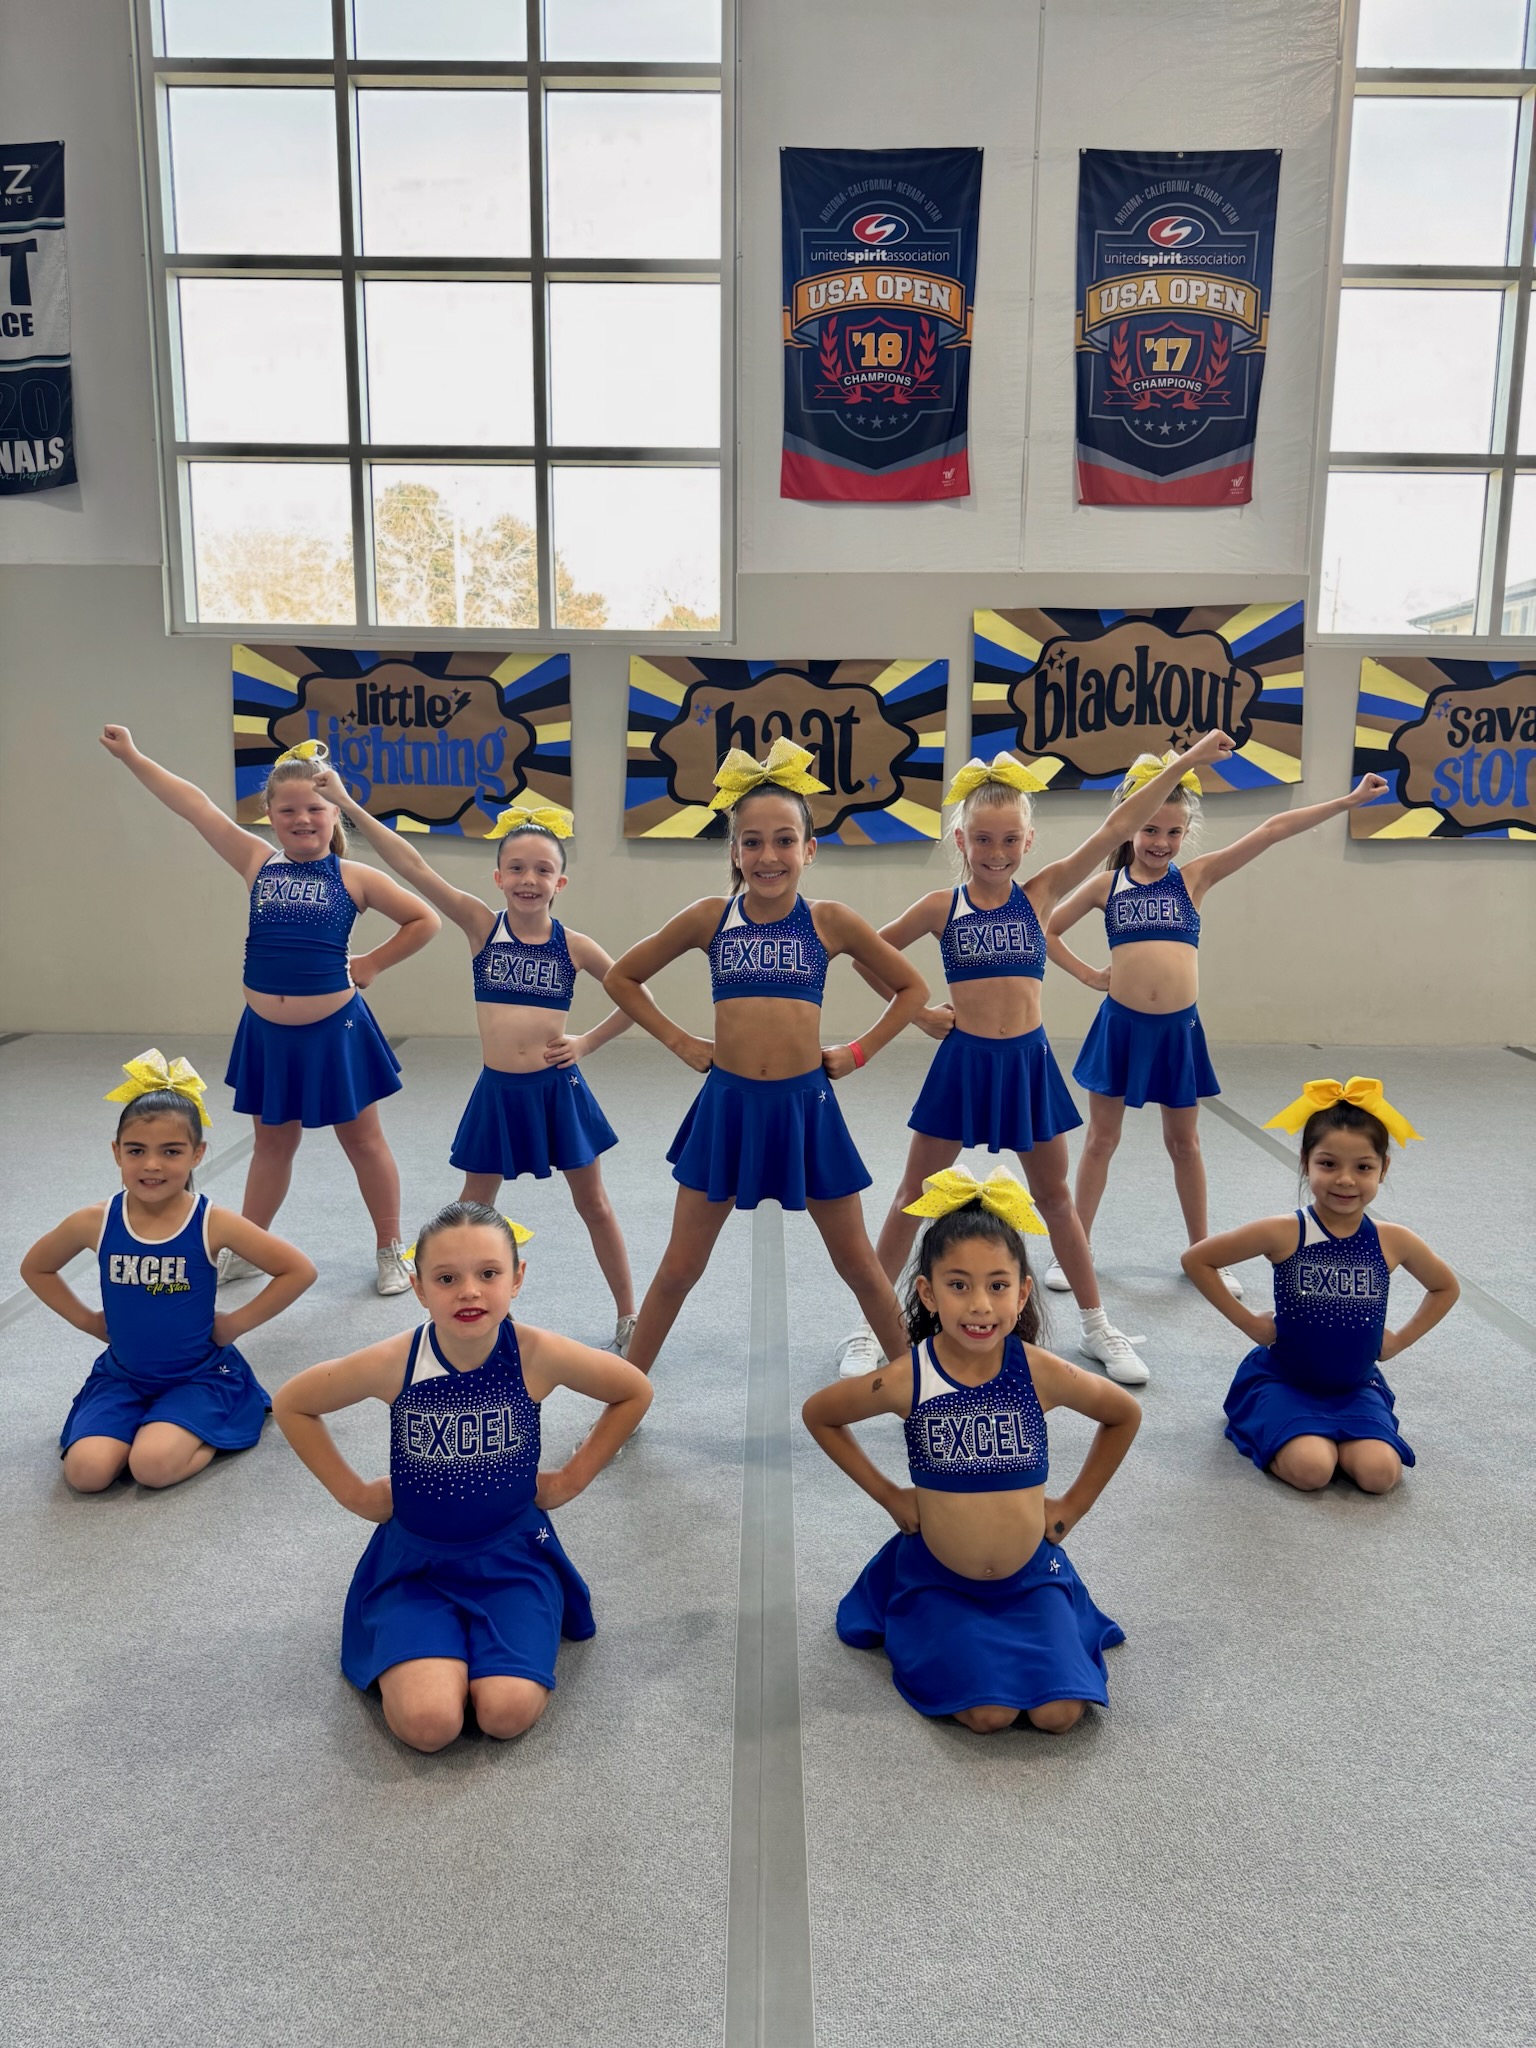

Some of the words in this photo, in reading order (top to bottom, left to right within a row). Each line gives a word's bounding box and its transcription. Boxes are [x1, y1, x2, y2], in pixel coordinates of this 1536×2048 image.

[819, 192, 847, 223] ARIZONA
[847, 179, 893, 198] CALIFORNIA
[896, 181, 926, 205] NEVADA
[924, 200, 943, 223] UTAH
[1114, 194, 1143, 226] ARIZONA
[1144, 180, 1190, 200] CALIFORNIA
[1193, 183, 1223, 207] NEVADA
[1221, 202, 1240, 225] UTAH
[808, 276, 869, 310] USA
[875, 275, 951, 311] OPEN
[1100, 278, 1161, 315] USA
[1169, 278, 1246, 316] OPEN
[0, 312, 34, 338] CE
[852, 332, 902, 367] '18
[1144, 337, 1191, 372] '17
[844, 372, 912, 387] CHAMPIONS
[1132, 377, 1203, 392] CHAMPIONS
[356, 682, 453, 728] little
[1034, 645, 1248, 750] blackout
[259, 877, 328, 905] EXCEL
[1116, 898, 1183, 926] EXCEL
[721, 939, 810, 974] EXCEL
[956, 922, 1035, 956] EXCEL
[490, 952, 562, 991] EXCEL
[110, 1254, 189, 1285] EXCEL
[1299, 1263, 1380, 1298] EXCEL
[405, 1406, 521, 1459] EXCEL
[925, 1411, 1032, 1461] EXCEL
